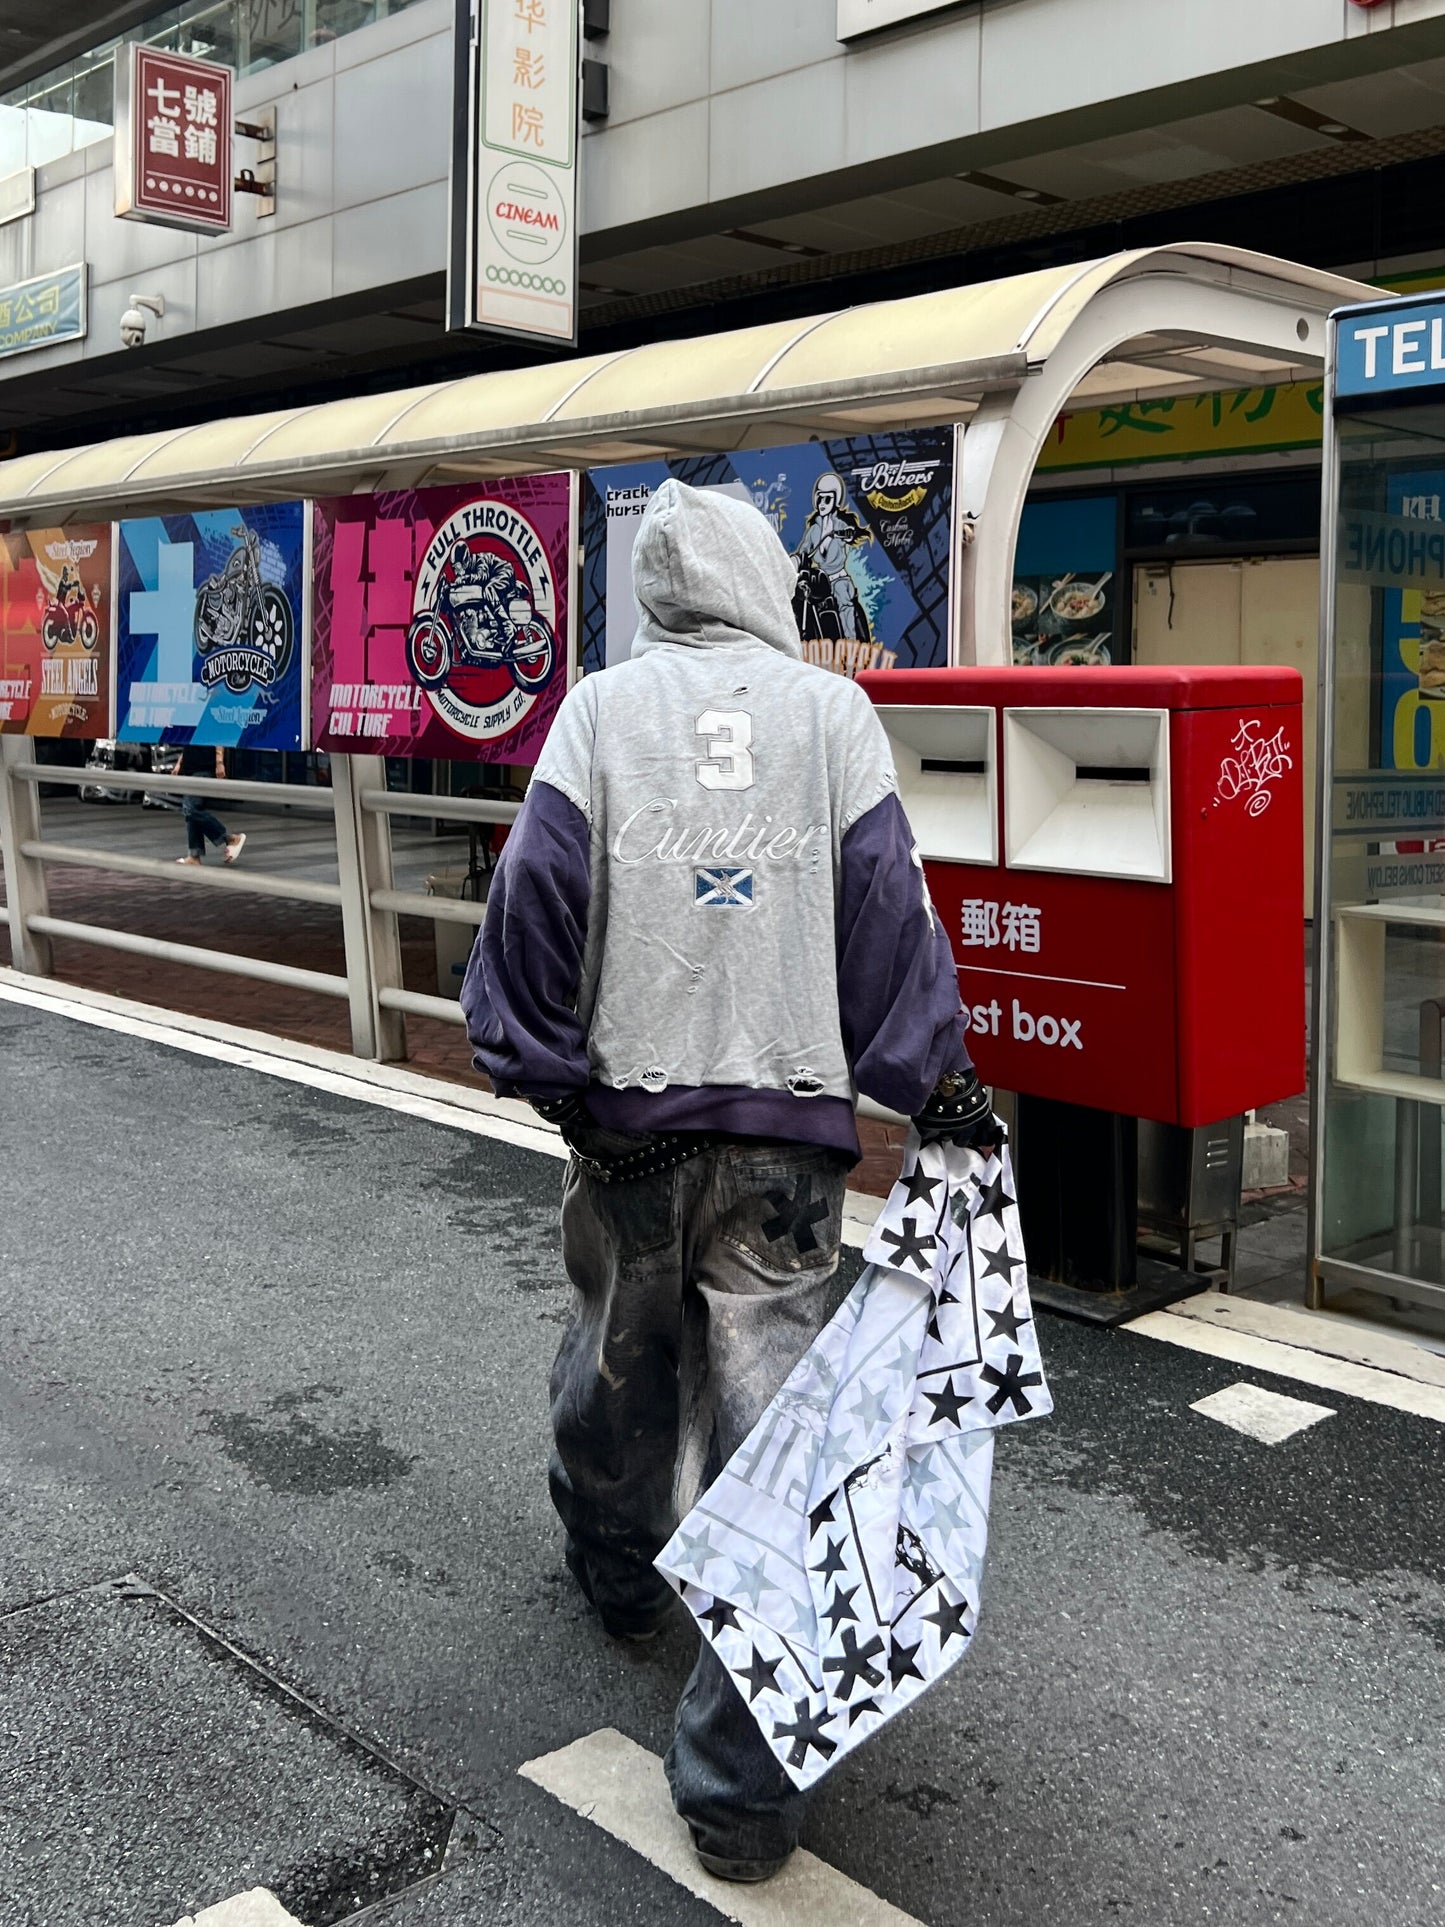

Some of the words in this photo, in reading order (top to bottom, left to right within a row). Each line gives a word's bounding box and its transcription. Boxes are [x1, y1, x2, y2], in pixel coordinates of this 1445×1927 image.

[147, 77, 218, 127] 七號
[147, 115, 218, 166] 當鋪
[495, 201, 559, 232] CINEAM
[606, 484, 650, 501] crack
[861, 459, 935, 492] Bikers
[426, 521, 461, 571] FULL
[462, 506, 542, 568] THROTTLE
[41, 658, 66, 695] STEEL
[66, 658, 98, 696] ANGELS
[207, 651, 270, 680] MOTORCYCLE
[328, 683, 423, 711] MOTORCYCLE
[436, 690, 481, 729] MOTORCYCLE
[483, 704, 511, 729] SUPPLY
[328, 711, 393, 738] CULTURE
[694, 708, 755, 792] 3
[961, 898, 1042, 953] 郵箱
[957, 999, 1002, 1036] st
[1012, 998, 1083, 1050] box
